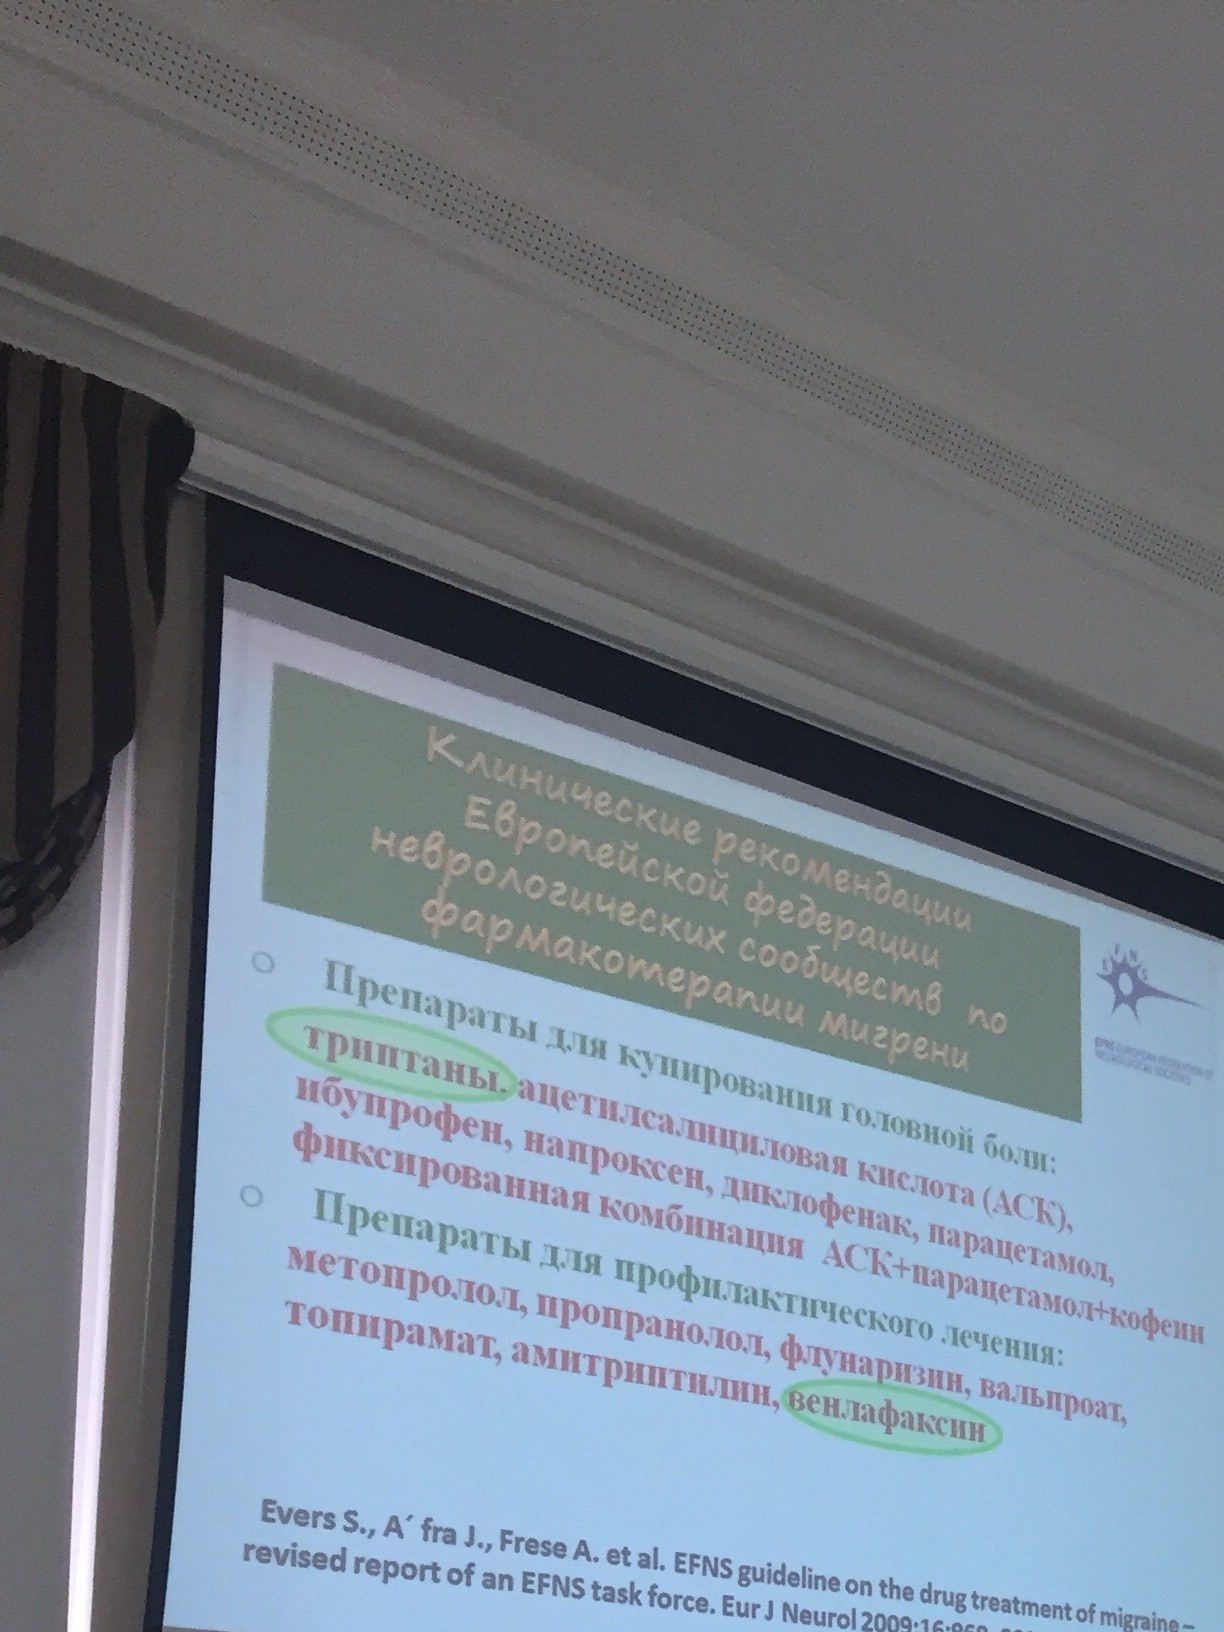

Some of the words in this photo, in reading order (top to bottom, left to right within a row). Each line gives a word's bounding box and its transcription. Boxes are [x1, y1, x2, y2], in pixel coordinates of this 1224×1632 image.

[426, 726, 702, 846] Клинические
[713, 828, 972, 933] рекомендации
[464, 796, 729, 905] Европейской
[745, 880, 939, 969] федерации
[371, 827, 728, 953] неврологических
[738, 936, 942, 1016] сообществ
[968, 1004, 1008, 1034] по
[421, 895, 804, 1026] фармакотерапии
[818, 1010, 968, 1073] мигрени
[324, 959, 538, 1042] Препараты
[546, 1025, 607, 1060] для
[620, 1042, 832, 1118] купирования
[842, 1105, 974, 1154] головной
[983, 1132, 1057, 1174] боли:
[517, 1077, 847, 1177] ацетилсалициловая
[858, 1161, 975, 1207] кислота
[983, 1185, 1073, 1234] (АСК),
[293, 1122, 590, 1213] фиксированная
[599, 1195, 804, 1259] комбинация
[822, 1239, 1205, 1345] АСК+парацетамол+кофеин
[296, 1075, 512, 1152] ибупрофен,
[524, 1128, 714, 1196] напроксен,
[722, 1174, 919, 1243] диклофенак,
[929, 1223, 1114, 1287] парацетамол,
[287, 1246, 528, 1317] метопролол,
[536, 1293, 771, 1362] пропранолол,
[780, 1333, 971, 1399] флунаризин,
[979, 1376, 1128, 1427] вальпроат,
[314, 1187, 532, 1262] Препараты
[540, 1243, 602, 1276] для
[615, 1258, 934, 1343] профилактического
[941, 1324, 1064, 1366] лечения:
[285, 1301, 501, 1365] топирамат,
[511, 1341, 779, 1413] амитриптилин,
[788, 1390, 985, 1443] венлафаксин
[243, 1540, 347, 1572] revised
[354, 1554, 440, 1584] report
[447, 1563, 476, 1586] of
[482, 1571, 514, 1592] an
[522, 1571, 586, 1599] EFNS
[591, 1579, 643, 1607] task
[648, 1584, 716, 1615] force.
[722, 1595, 762, 1620] Eur
[764, 1600, 774, 1622] J
[782, 1603, 856, 1631] Neurol
[261, 1498, 336, 1531] Evers
[342, 1510, 376, 1538] S.,
[422, 1518, 457, 1545] fra
[464, 1525, 492, 1554] J.,
[500, 1529, 567, 1560] Frese
[573, 1539, 600, 1563] A.
[607, 1545, 631, 1568] et
[638, 1546, 665, 1572] al.
[674, 1551, 732, 1579] EFNS
[738, 1563, 841, 1593] guideline
[845, 1576, 873, 1597] on
[878, 1576, 914, 1602] the
[920, 1582, 967, 1614] drug
[971, 1590, 1072, 1622] treatment
[1076, 1602, 1097, 1624] of
